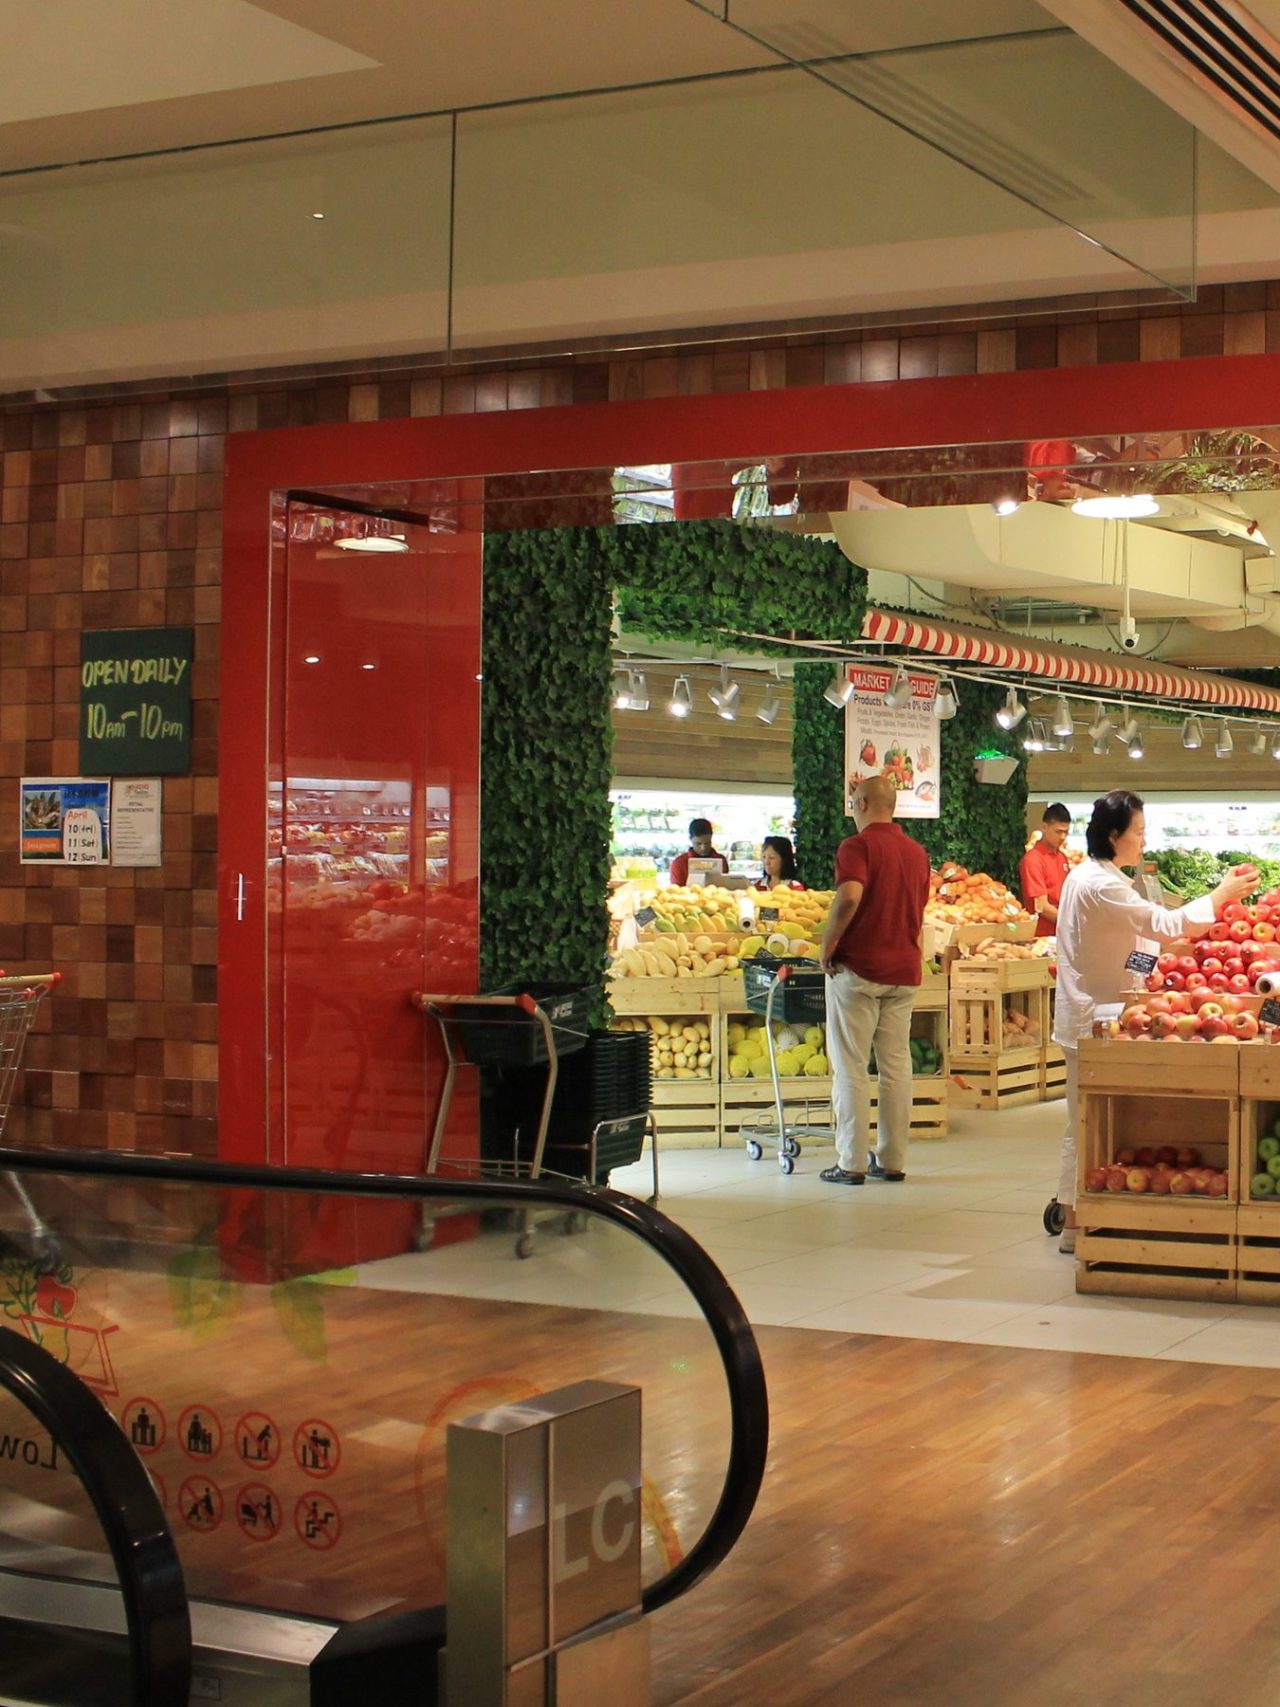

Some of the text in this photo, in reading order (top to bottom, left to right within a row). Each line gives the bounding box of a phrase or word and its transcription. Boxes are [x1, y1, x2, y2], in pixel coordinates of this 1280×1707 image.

[82, 656, 187, 688] OPEN DAILY
[853, 672, 891, 690] MARKET
[853, 693, 882, 706] Products
[69, 824, 78, 834] 10
[69, 838, 77, 848] 11
[68, 852, 78, 862] 12
